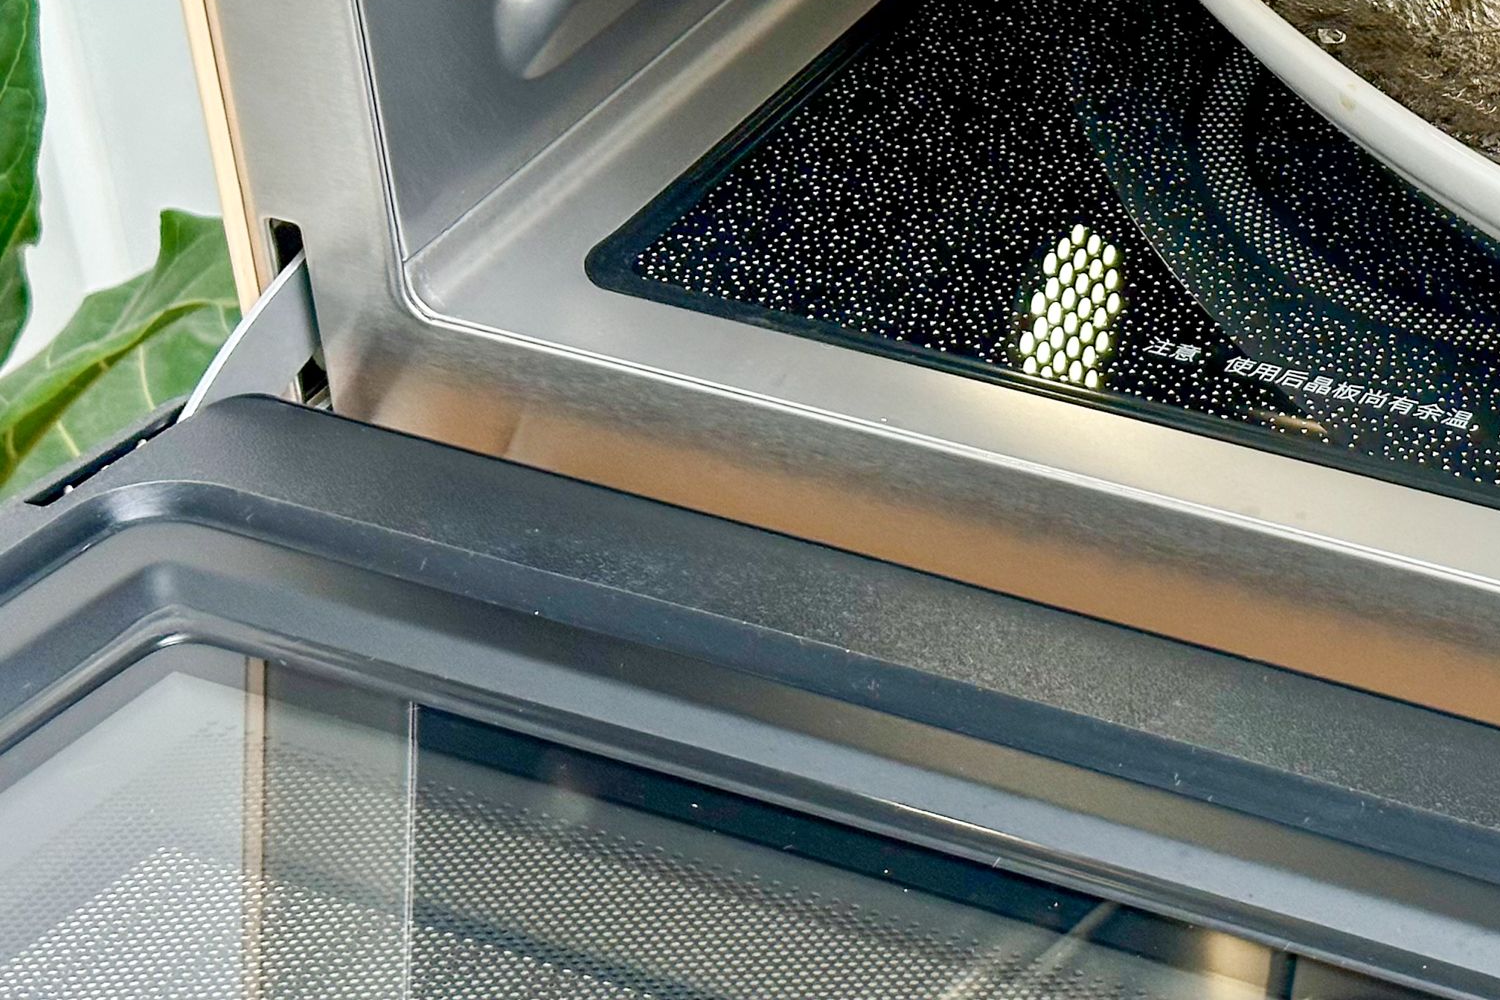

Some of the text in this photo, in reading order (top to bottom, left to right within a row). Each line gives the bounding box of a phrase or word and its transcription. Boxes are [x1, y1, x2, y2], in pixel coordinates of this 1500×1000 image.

[1142, 334, 1203, 364] 注意
[1223, 354, 1480, 433] 使用后晶板尚有余温，
